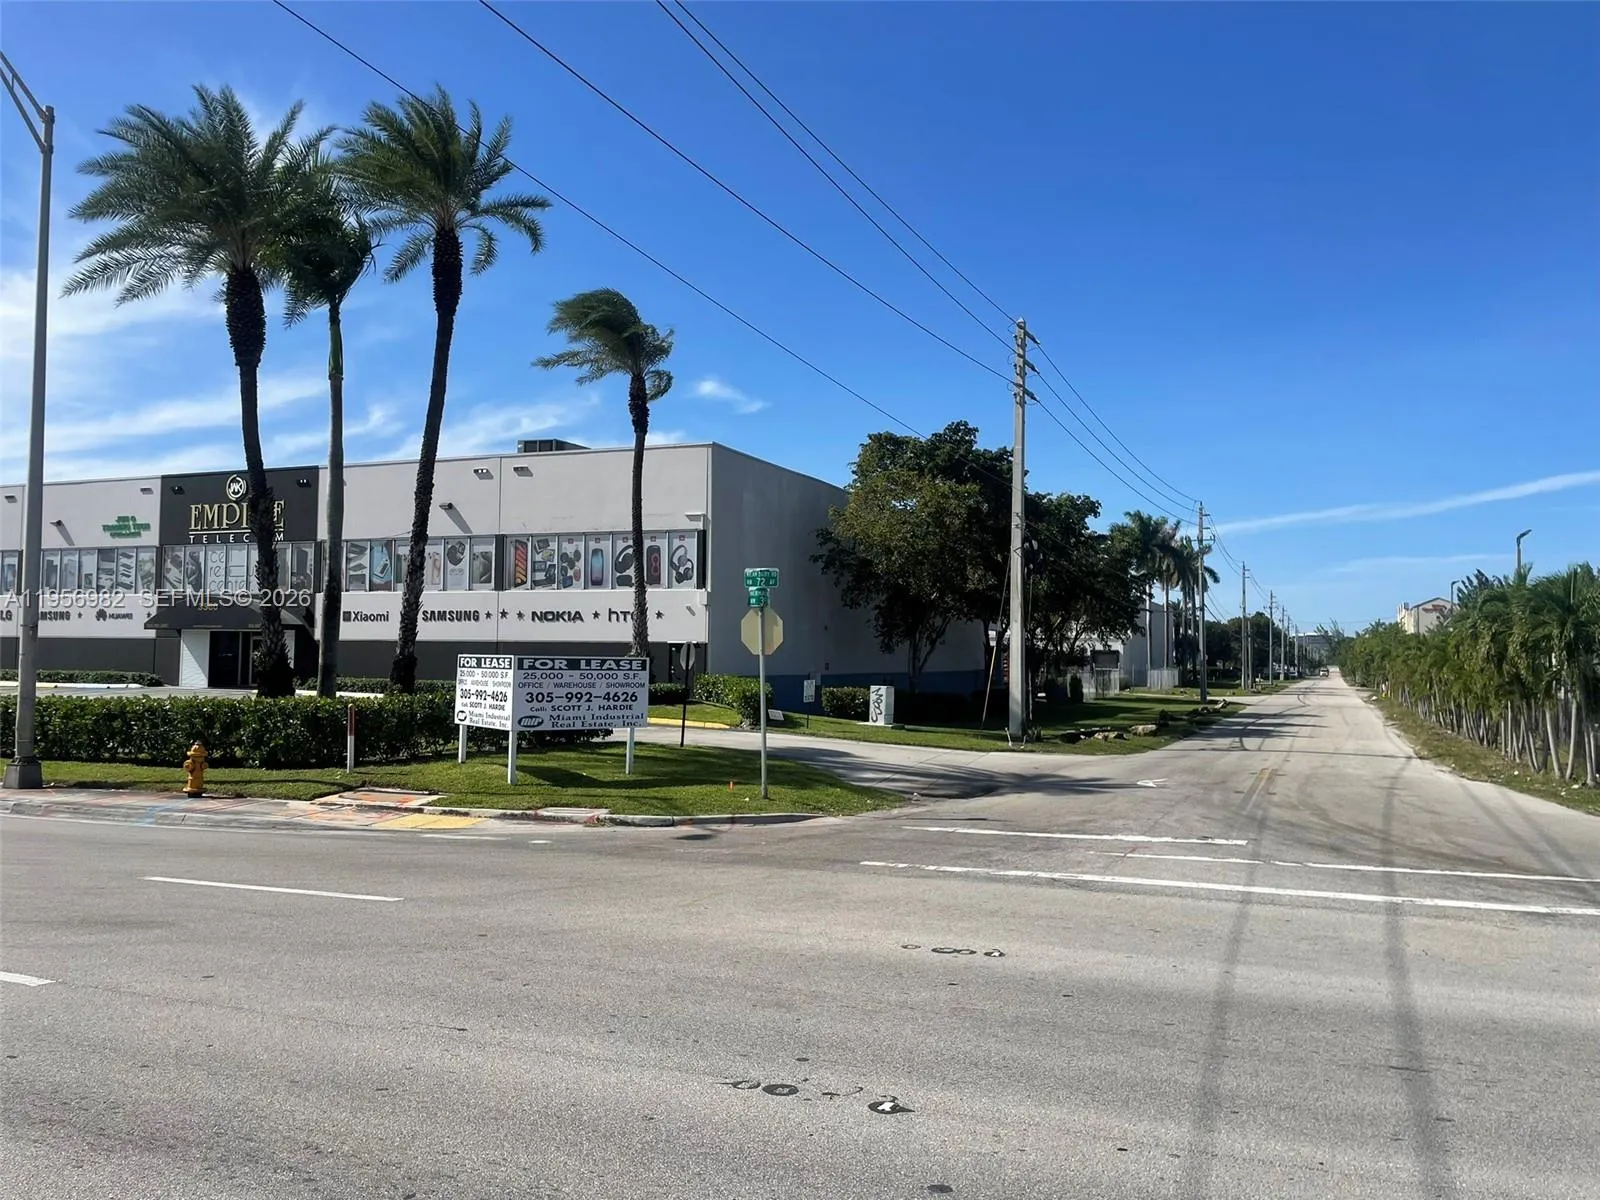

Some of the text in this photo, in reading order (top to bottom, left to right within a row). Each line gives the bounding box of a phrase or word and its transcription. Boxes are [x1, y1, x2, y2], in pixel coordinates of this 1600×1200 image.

[189, 500, 285, 530] EMPIE
[189, 532, 284, 544] TELECM
[756, 577, 766, 587] 72
[39, 610, 71, 621] MSUNG
[352, 610, 390, 622] Xiaomi
[422, 610, 480, 622] SAMSUNG
[531, 610, 584, 622] NOKIA
[460, 657, 511, 669] FOR LEASE
[523, 659, 643, 670] FOR LEASE
[523, 672, 564, 681] 25,000
[579, 672, 619, 681] 50,000
[623, 672, 642, 680] S.F.
[460, 688, 508, 702] 305-992-4626
[524, 691, 639, 703] 305-992-4626
[469, 710, 511, 721] Miami Industrial
[548, 712, 644, 721] Miami Industrial
[622, 720, 643, 728] Inc.
